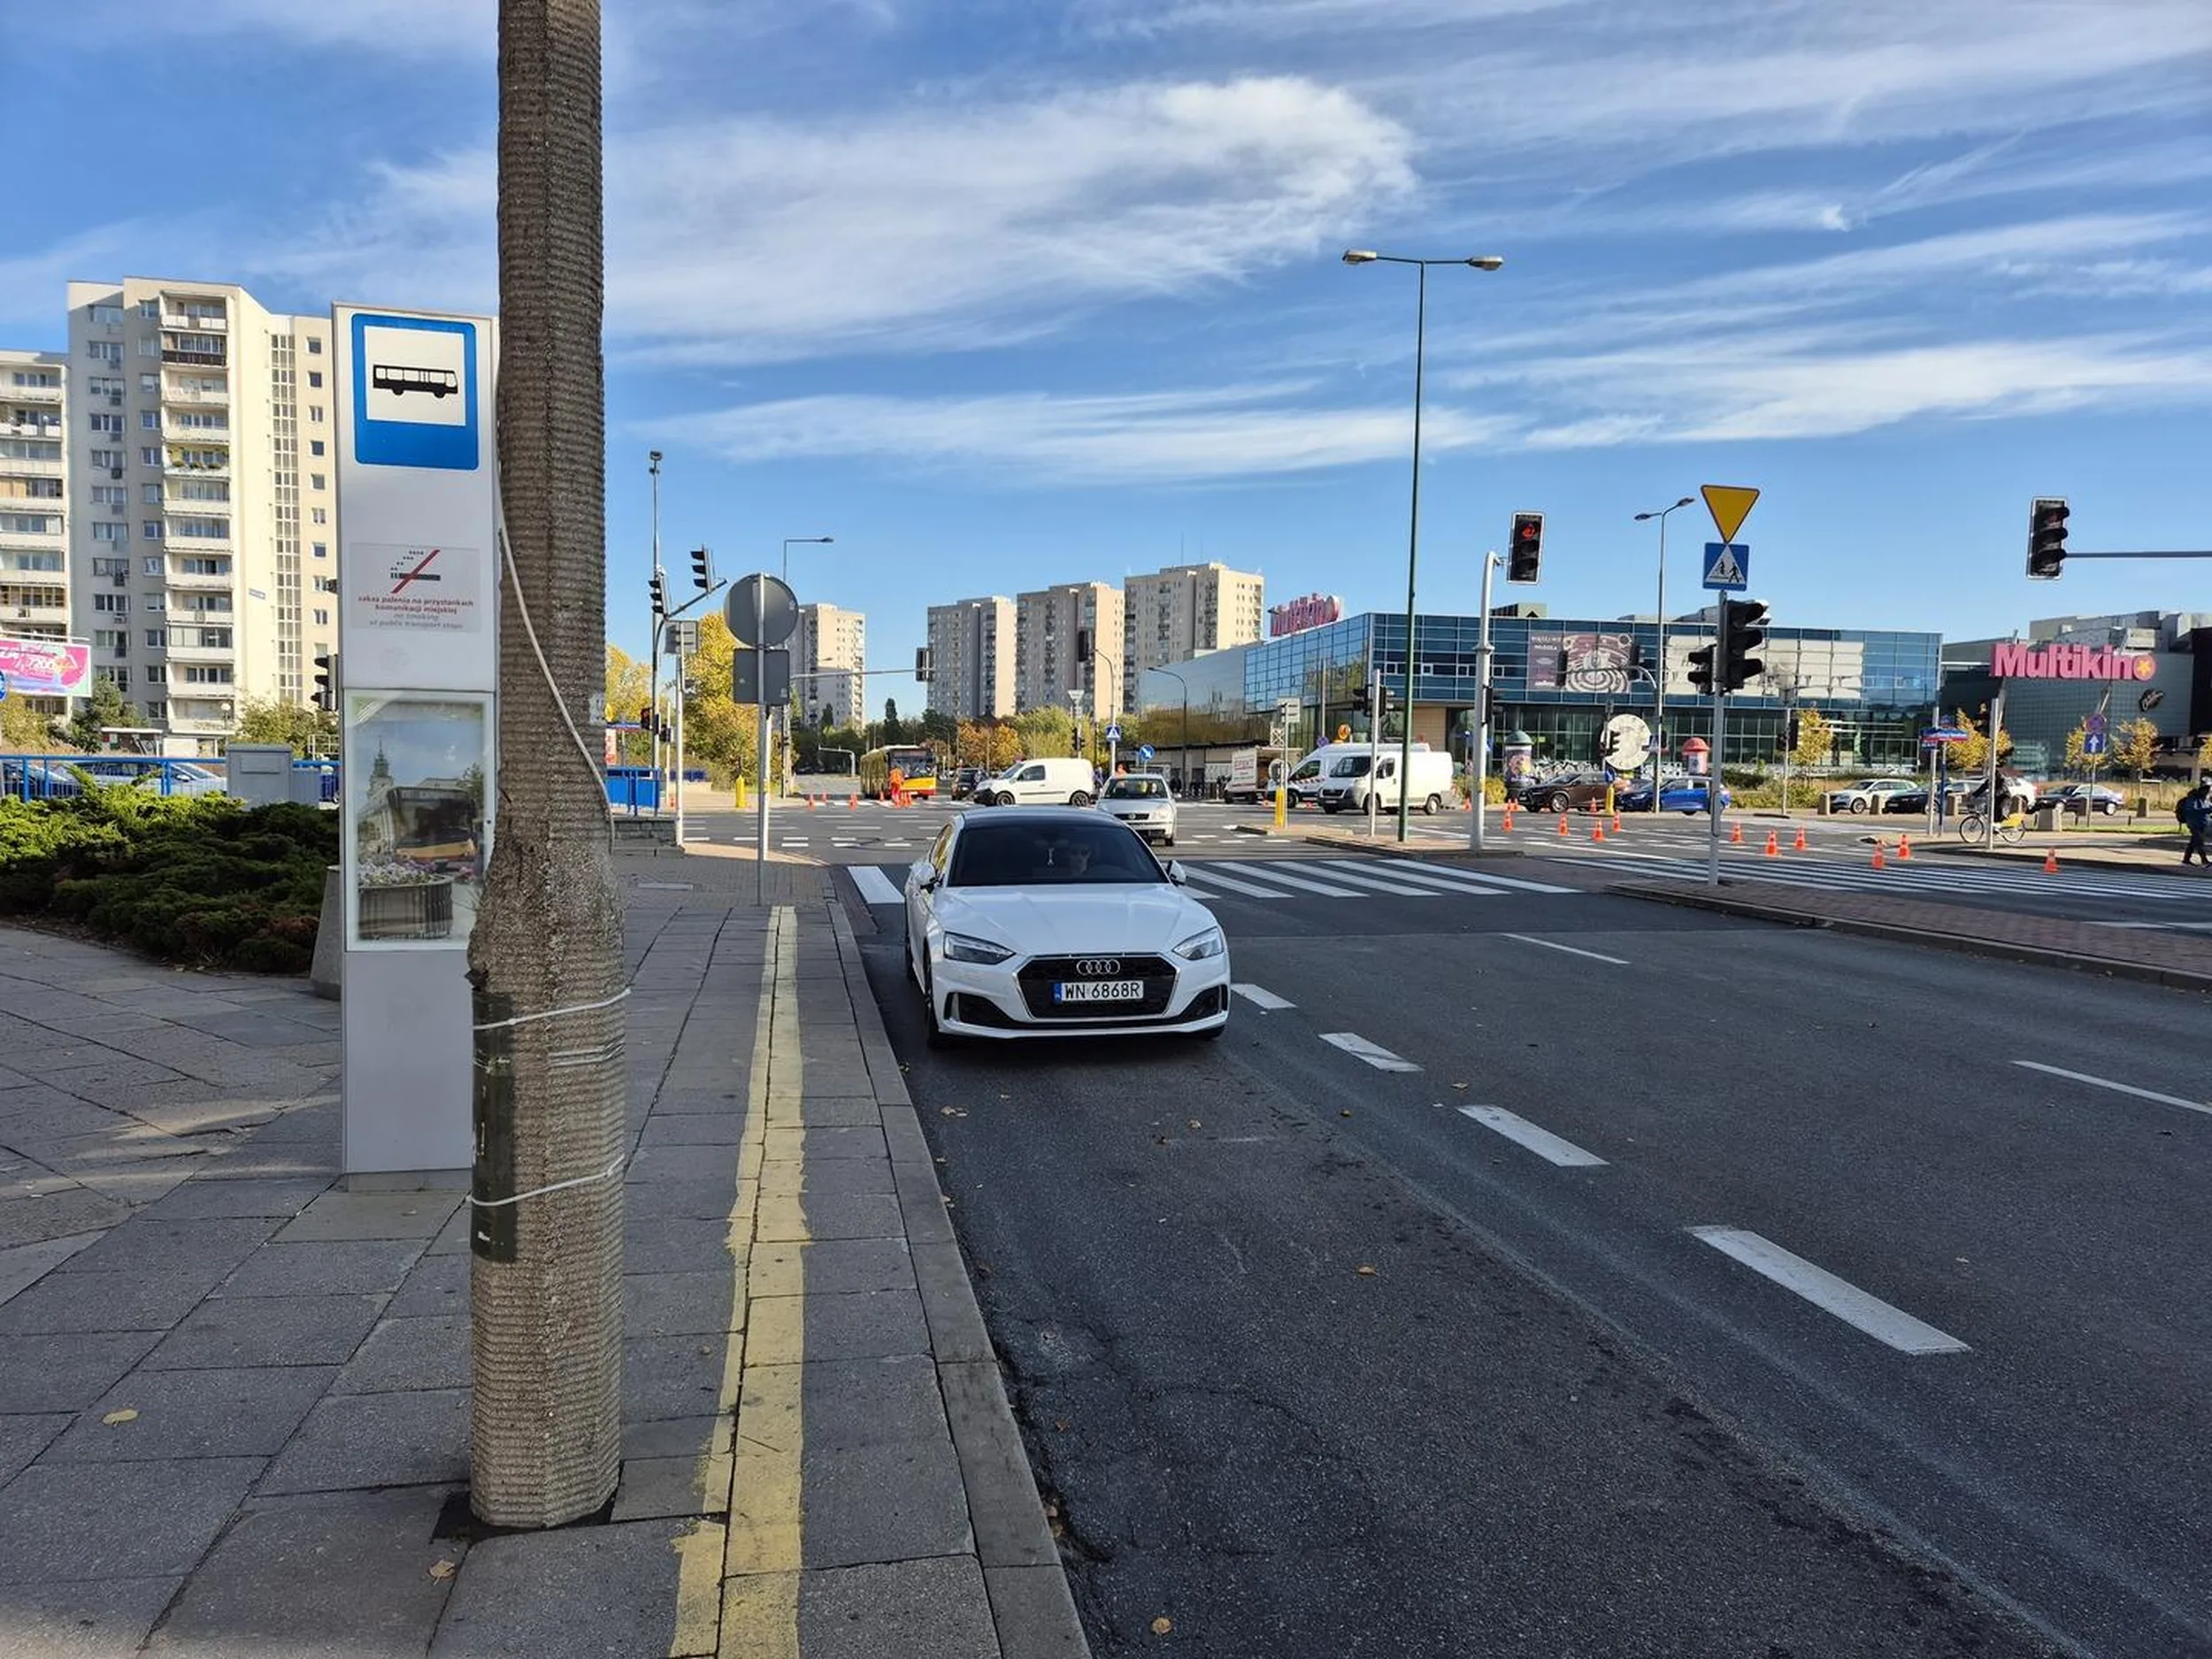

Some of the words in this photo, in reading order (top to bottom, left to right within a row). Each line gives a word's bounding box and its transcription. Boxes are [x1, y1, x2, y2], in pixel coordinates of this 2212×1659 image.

[375, 603, 422, 613] komunikacji
[424, 606, 457, 615] miejskiej
[423, 598, 474, 607] przystankach
[1993, 642, 2155, 681] Multikino
[1064, 984, 1086, 999] WN
[1091, 982, 1140, 998] 6868R
